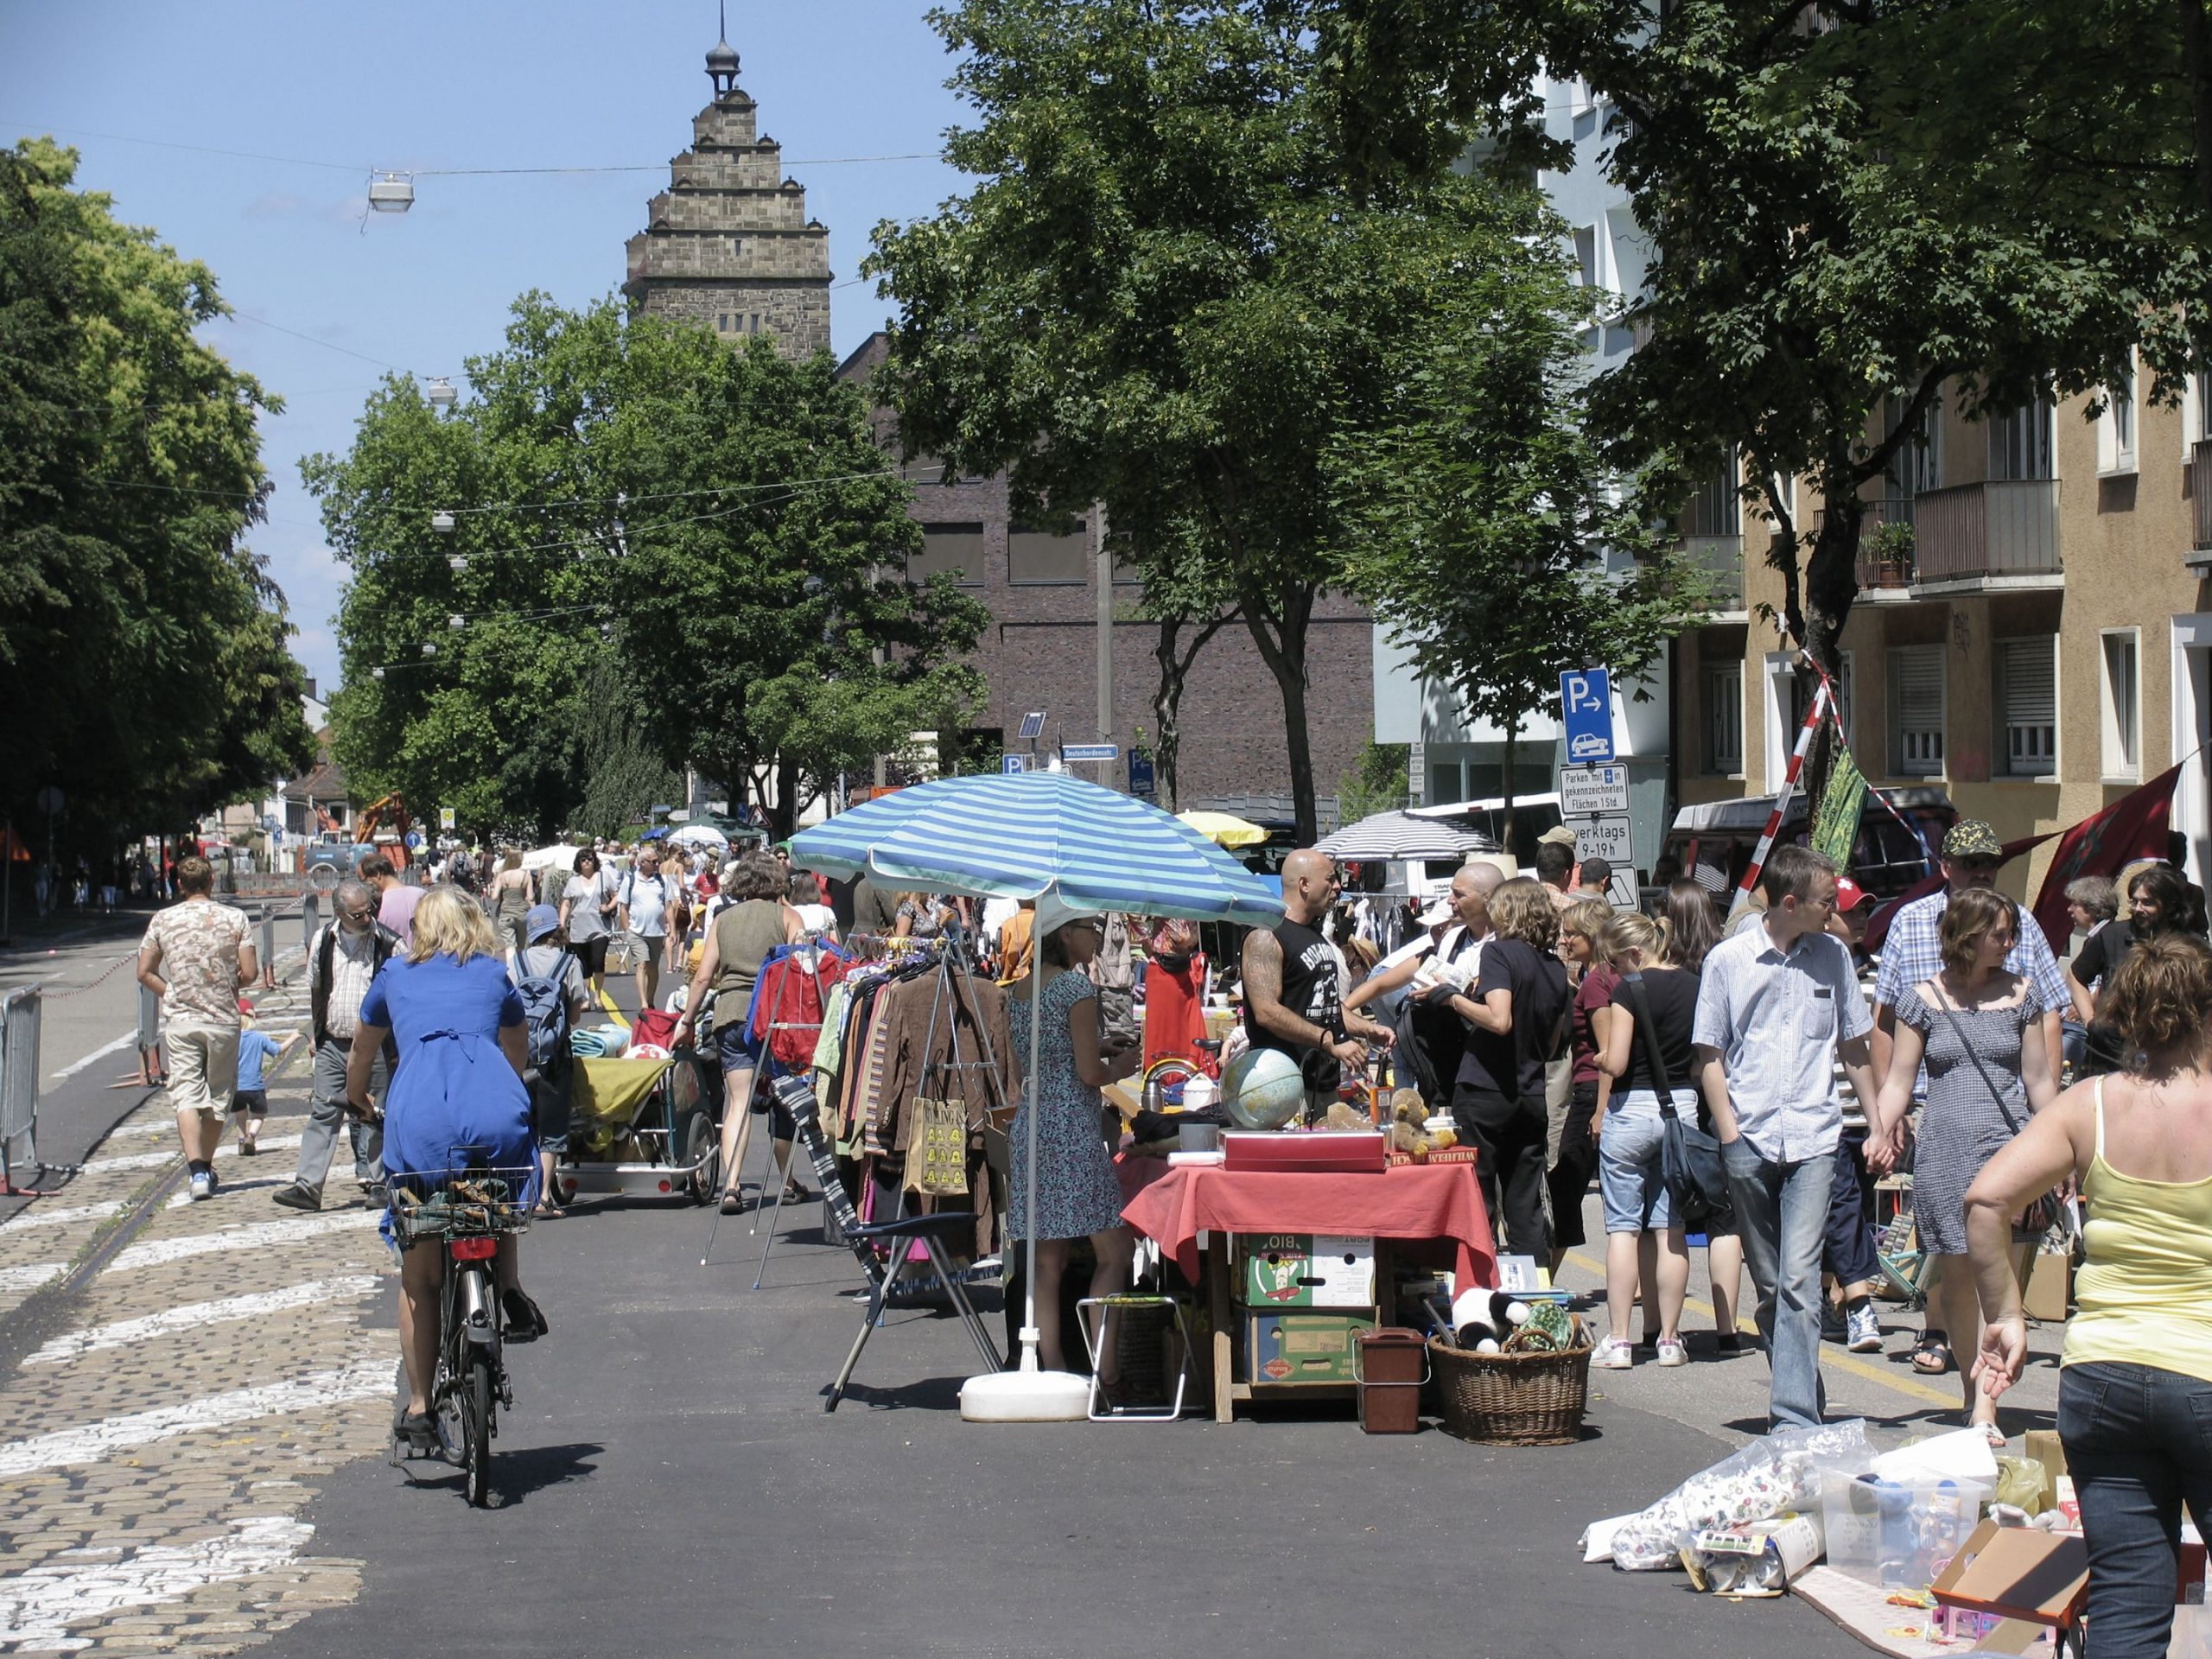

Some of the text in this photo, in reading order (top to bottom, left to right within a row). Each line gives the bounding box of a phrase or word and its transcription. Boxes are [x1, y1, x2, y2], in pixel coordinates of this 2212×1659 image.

[1568, 677, 1589, 713] P
[1008, 757, 1020, 774] P
[1132, 752, 1142, 769] P
[1566, 770, 1621, 783] Parken mit in
[1565, 785, 1624, 798] gekennzeichneten
[1572, 798, 1598, 810] Flächen
[1428, 1151, 1475, 1163] WILHELM
[1268, 1236, 1295, 1249] BIO
